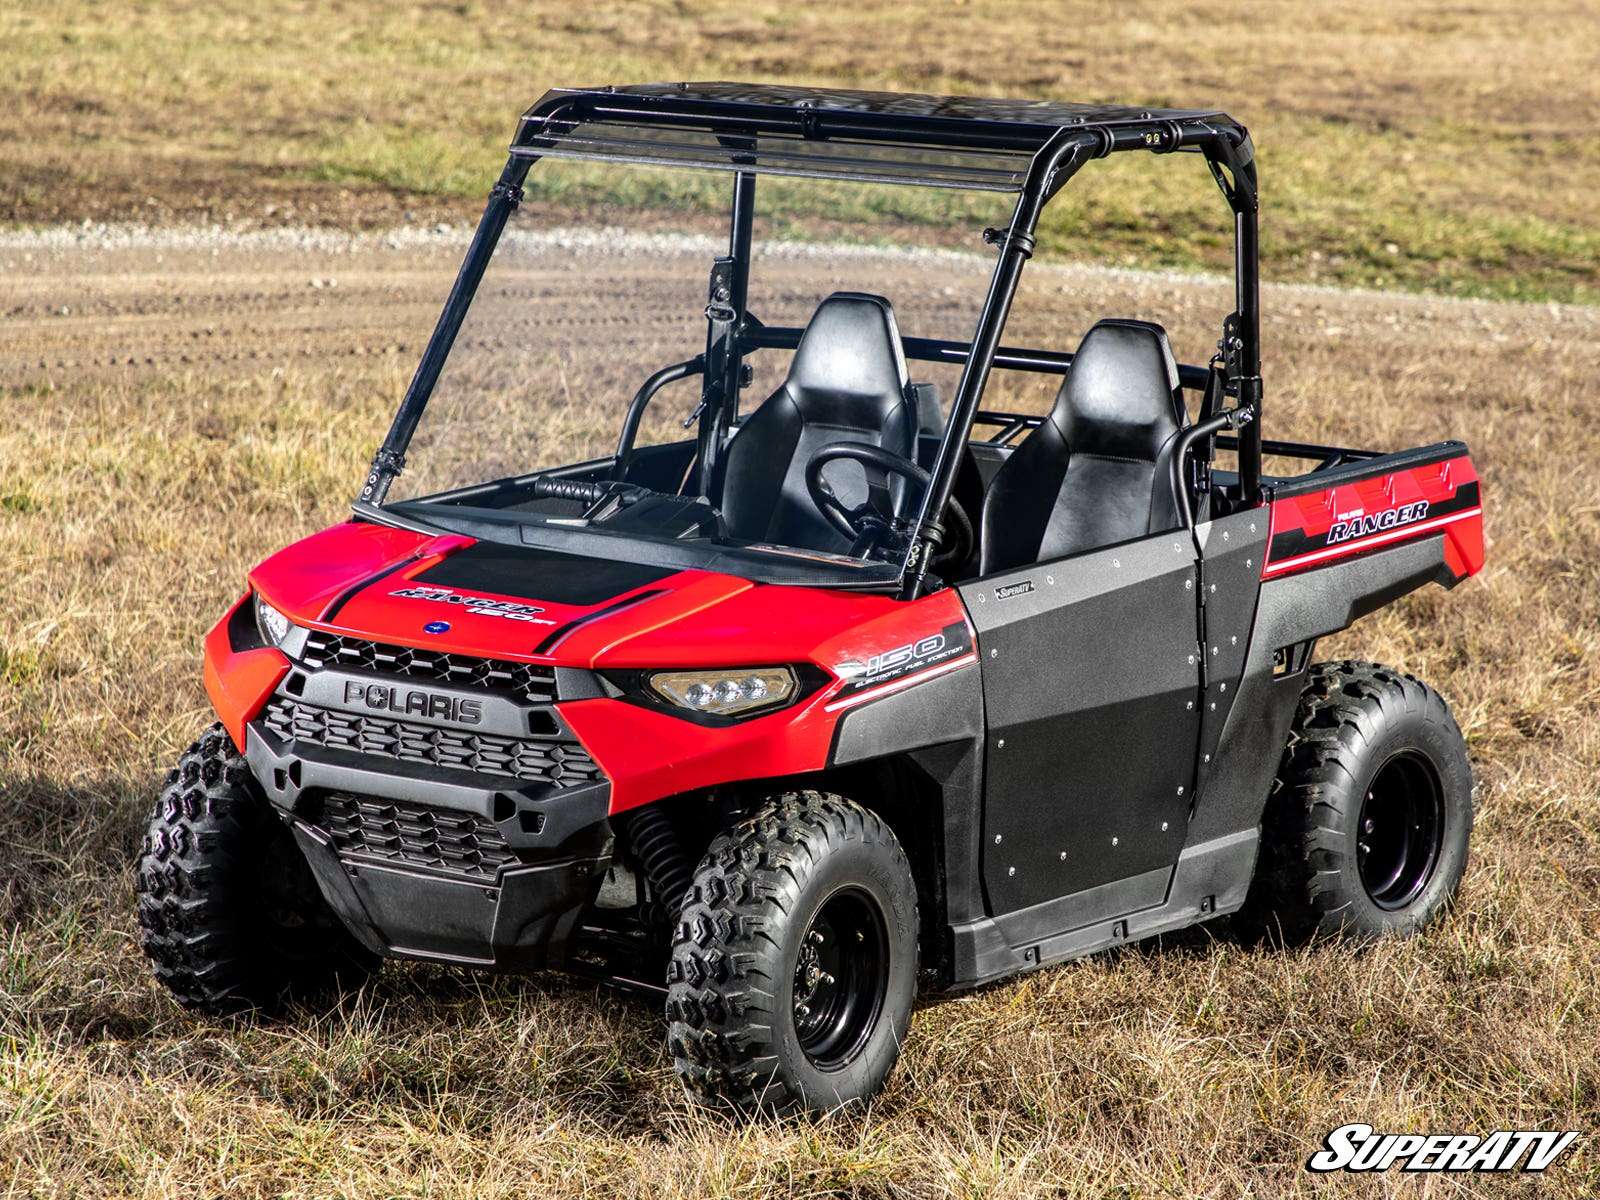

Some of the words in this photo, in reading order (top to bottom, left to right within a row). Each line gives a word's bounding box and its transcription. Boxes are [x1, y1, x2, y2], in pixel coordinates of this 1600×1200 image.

[1327, 500, 1429, 544] RANGER
[388, 588, 545, 614] RANGER
[866, 633, 945, 677] 150
[927, 645, 963, 663] INJECTION
[344, 680, 483, 724] POLARIS
